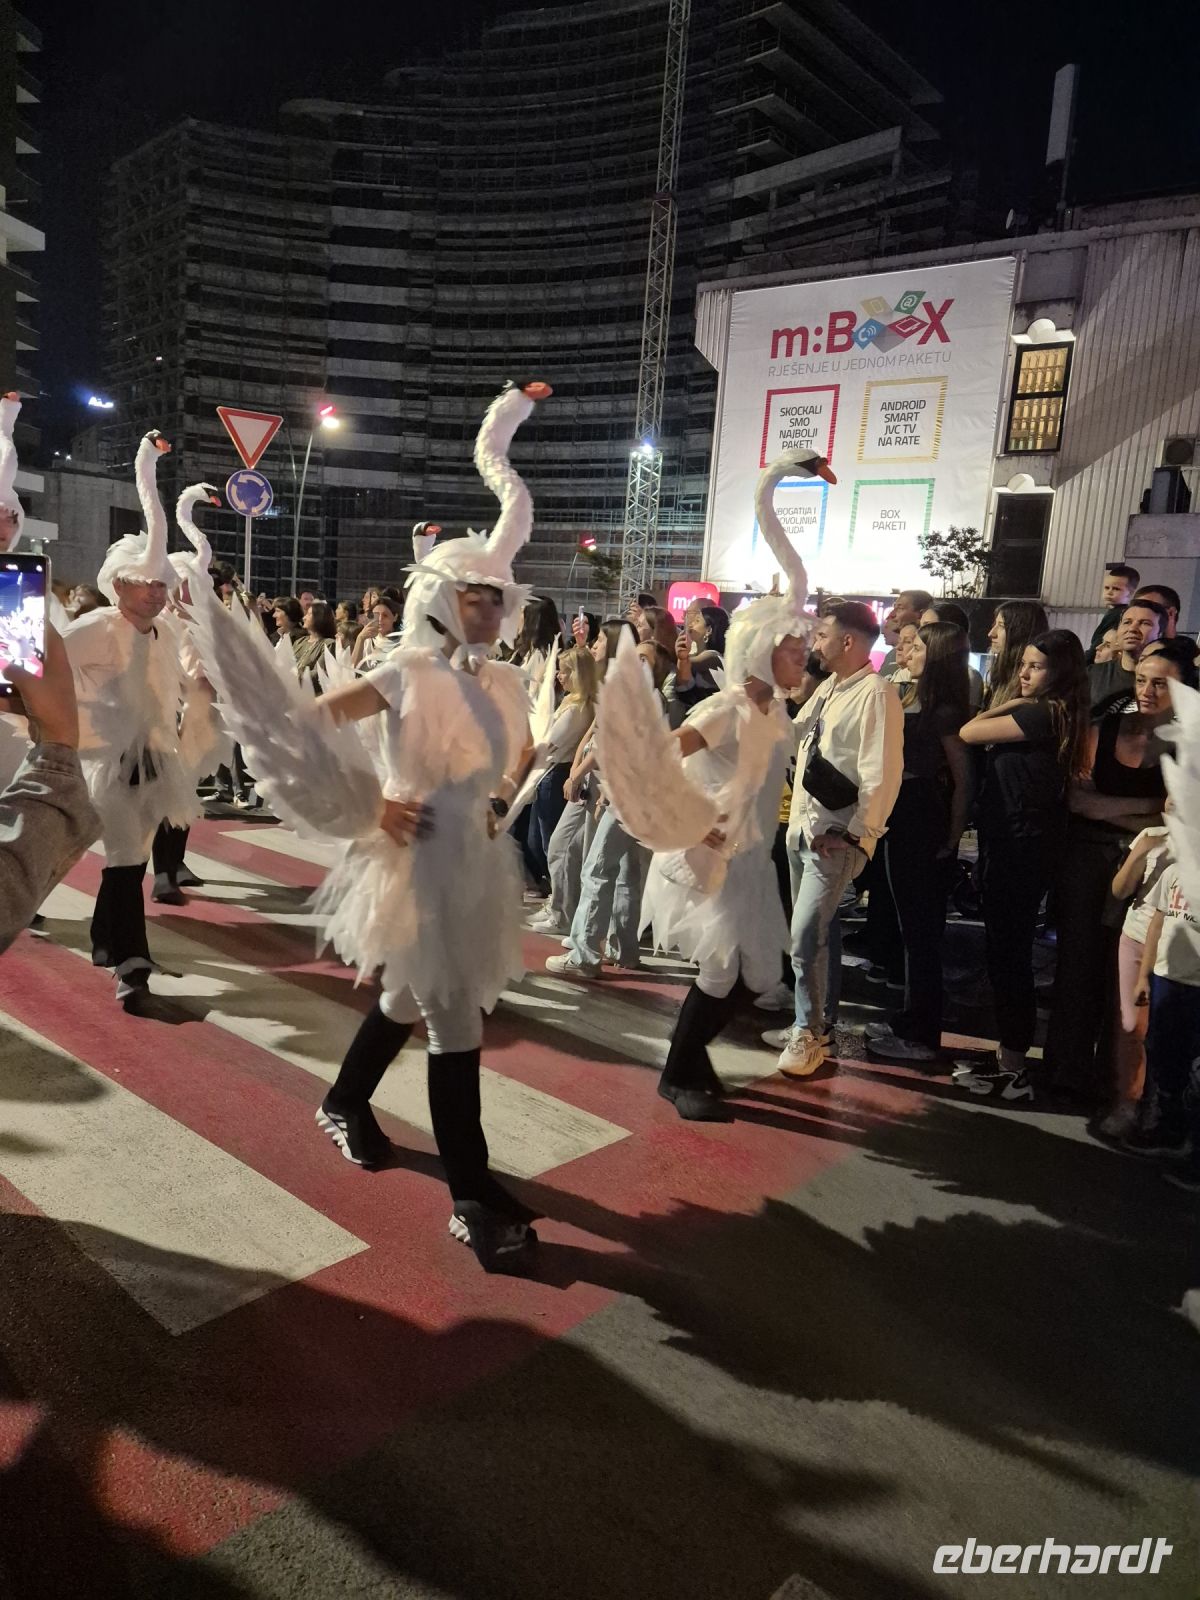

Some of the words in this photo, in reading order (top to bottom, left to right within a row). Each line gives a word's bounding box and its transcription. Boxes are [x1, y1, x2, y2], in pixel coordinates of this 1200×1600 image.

[768, 361, 829, 377] RJEŠENJE
[831, 360, 841, 372] U
[842, 356, 896, 371] JEDNOM
[899, 351, 952, 367] PAKETU
[779, 405, 823, 417] SKOCKALI
[880, 399, 927, 412] ANDROID
[789, 417, 811, 428] SMO
[884, 411, 921, 423] SMART
[779, 428, 818, 439] NAJBOLJI
[884, 424, 901, 435] JVC
[903, 423, 917, 434] TV
[781, 439, 813, 450] PAKET!
[877, 436, 892, 447] NA
[894, 435, 921, 446] RATE
[880, 509, 901, 519] BOX
[872, 520, 907, 531] PAKETI
